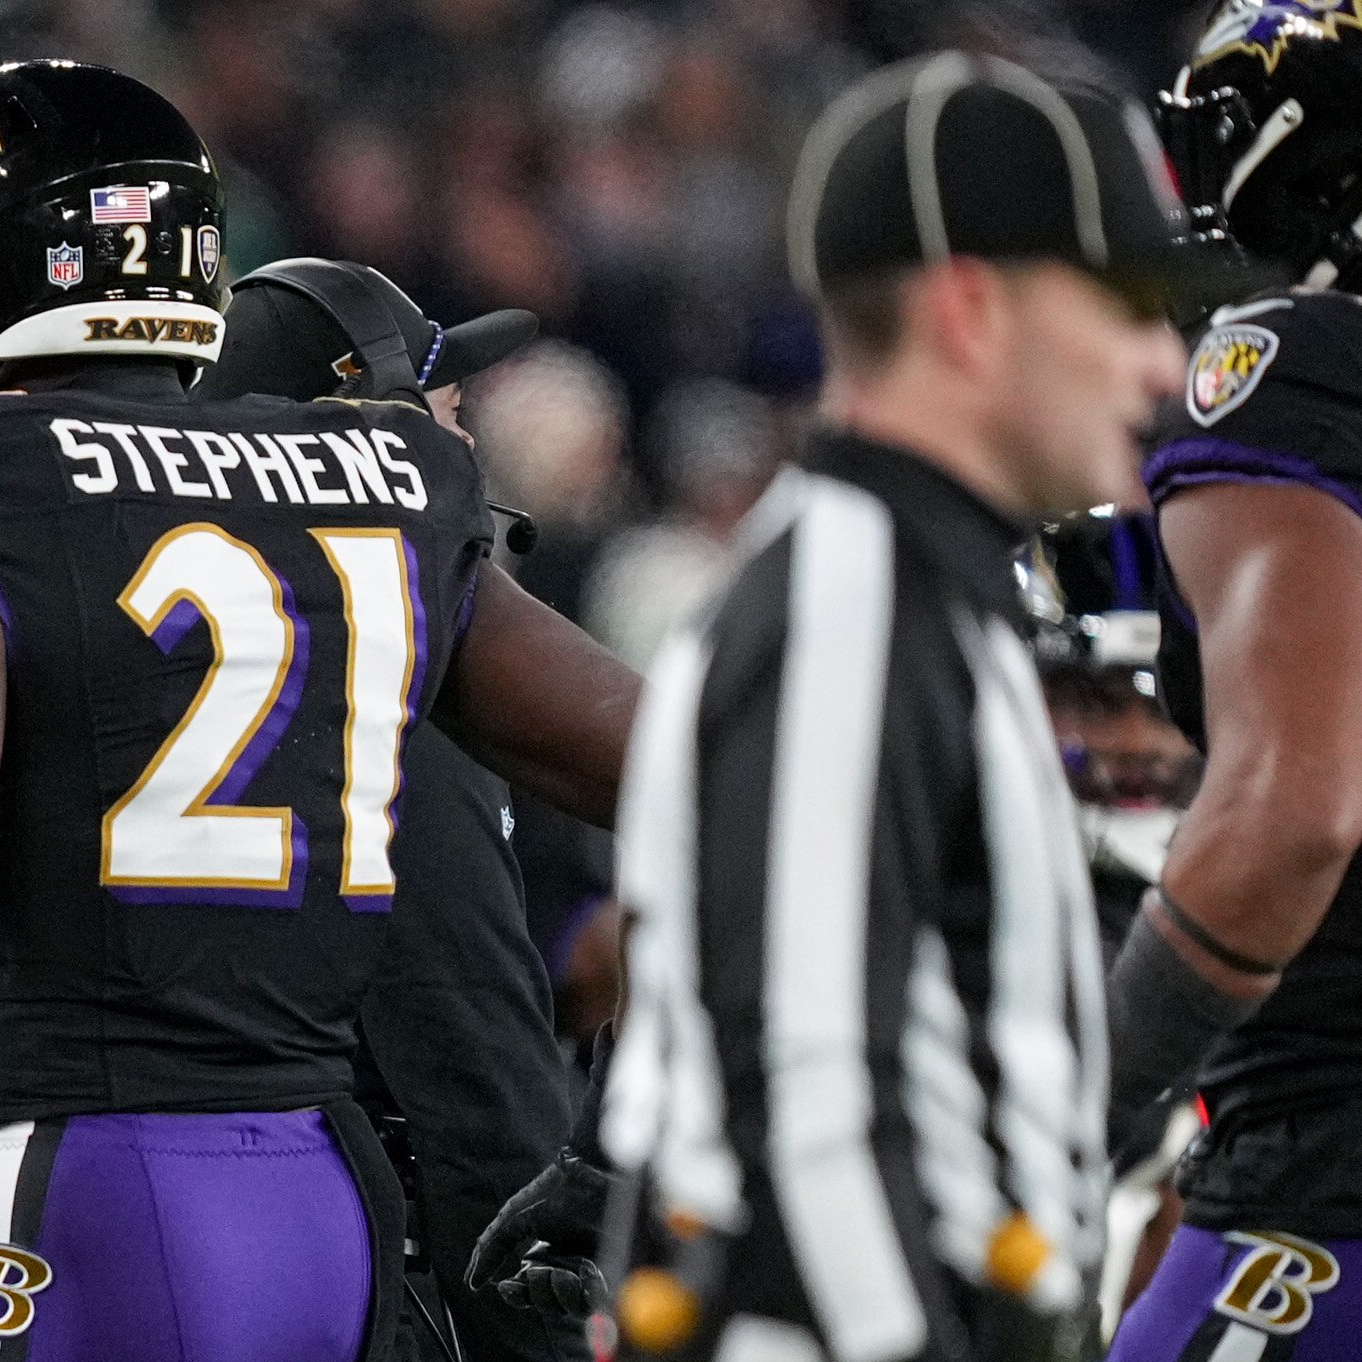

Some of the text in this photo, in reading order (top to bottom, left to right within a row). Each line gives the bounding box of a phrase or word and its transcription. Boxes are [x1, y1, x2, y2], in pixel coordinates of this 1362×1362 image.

[53, 263, 80, 281] NFL
[83, 316, 219, 345] RAVENS
[49, 418, 428, 511] STEPHENS
[100, 521, 420, 905] 21
[1213, 1231, 1341, 1334] B
